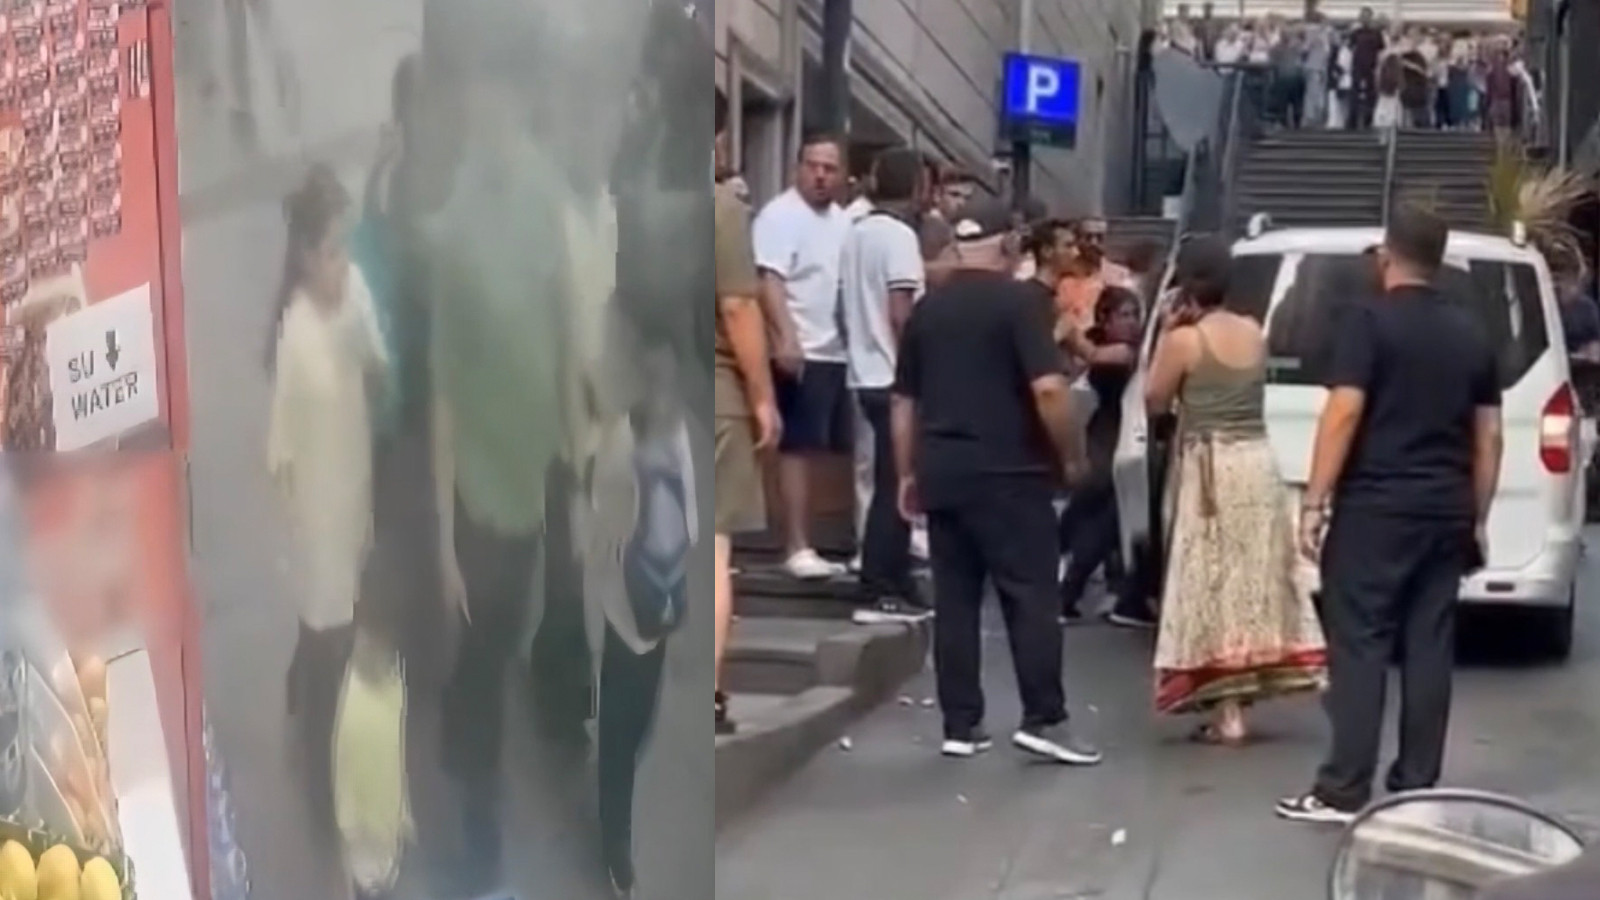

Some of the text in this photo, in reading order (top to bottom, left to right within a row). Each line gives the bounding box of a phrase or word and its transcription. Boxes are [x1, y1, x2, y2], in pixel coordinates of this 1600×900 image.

[1027, 65, 1059, 112] P
[68, 350, 94, 383] SU
[71, 371, 138, 421] WATER
